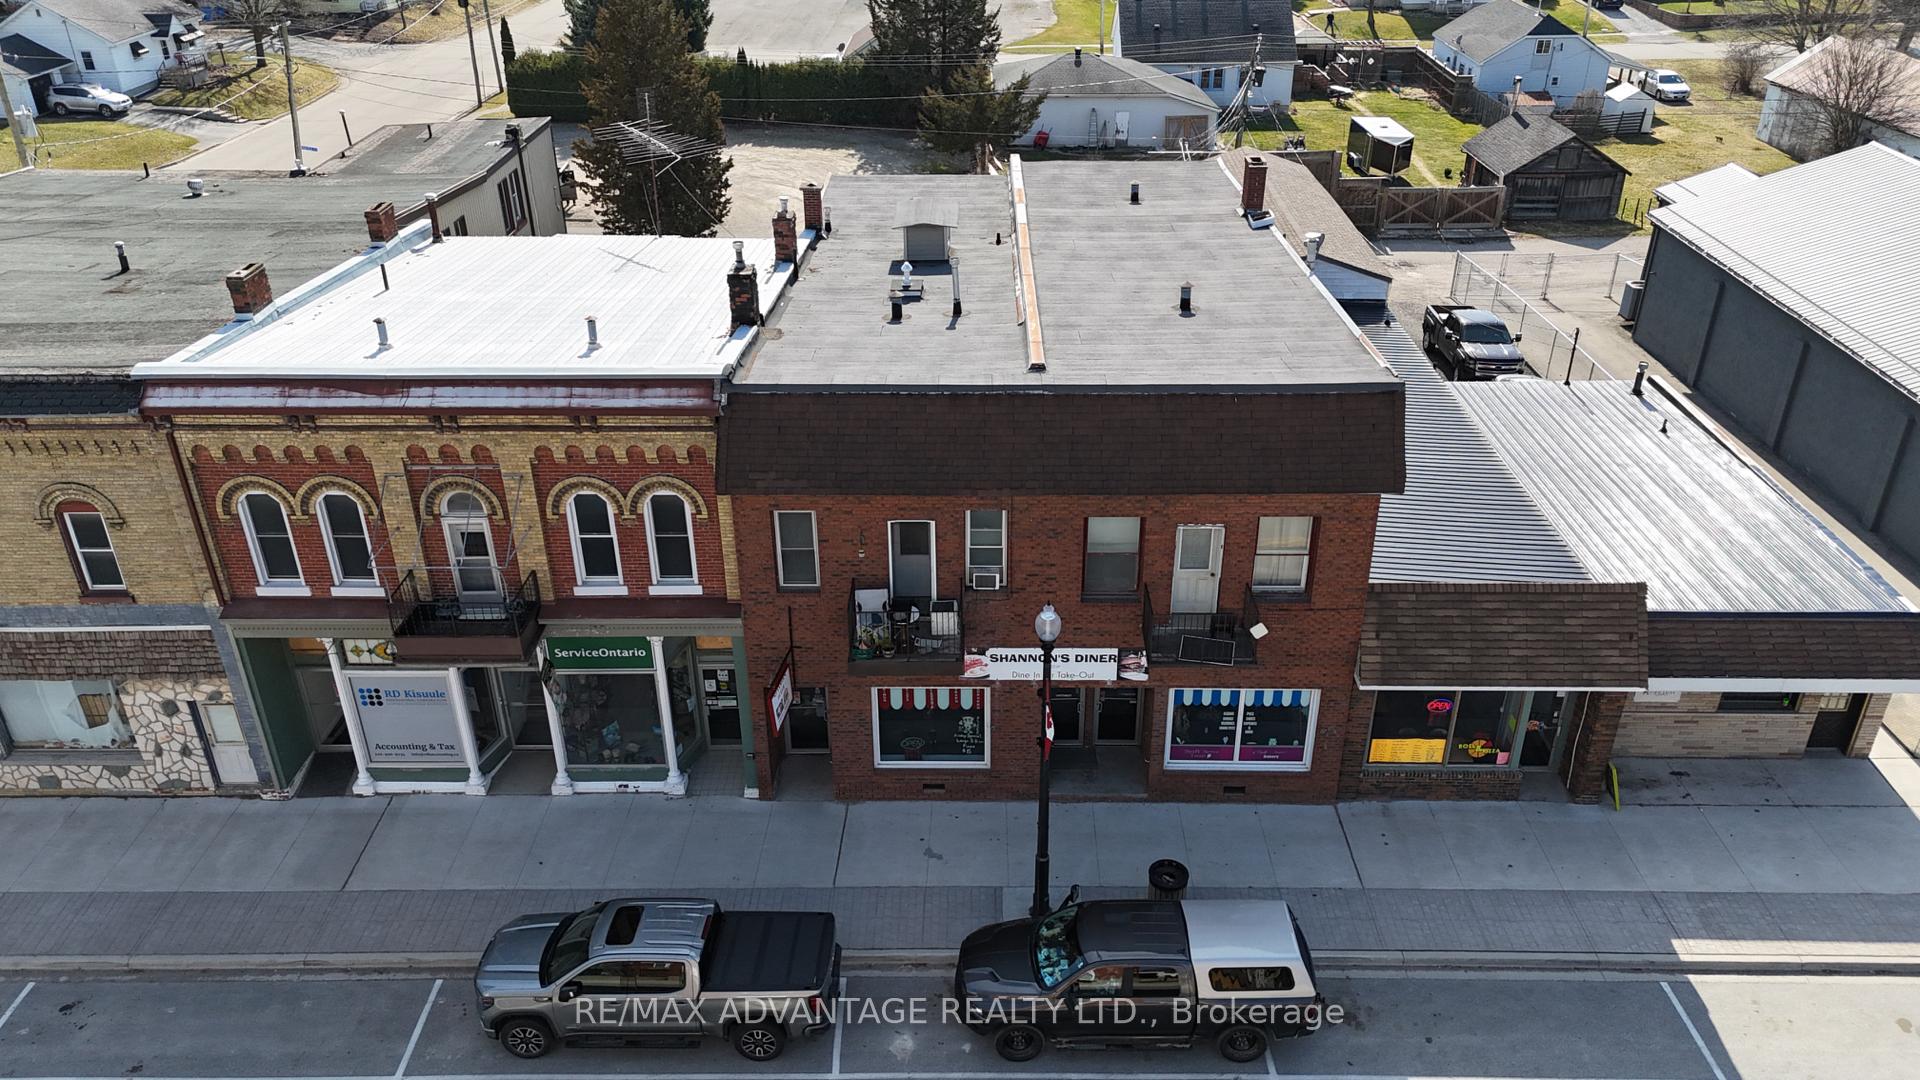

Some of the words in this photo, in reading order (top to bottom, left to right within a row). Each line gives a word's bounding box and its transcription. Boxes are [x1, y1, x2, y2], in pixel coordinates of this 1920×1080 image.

[554, 648, 646, 658] ServiceOntario
[989, 653, 1070, 663] SHANNON'S
[1074, 654, 1117, 663] DINER
[1011, 671, 1030, 679] Dine
[1057, 670, 1095, 679] Take-Out
[384, 690, 401, 698] RD
[404, 689, 446, 698] Kisuule
[1429, 701, 1451, 710] OPEN
[375, 743, 428, 752] Accounting
